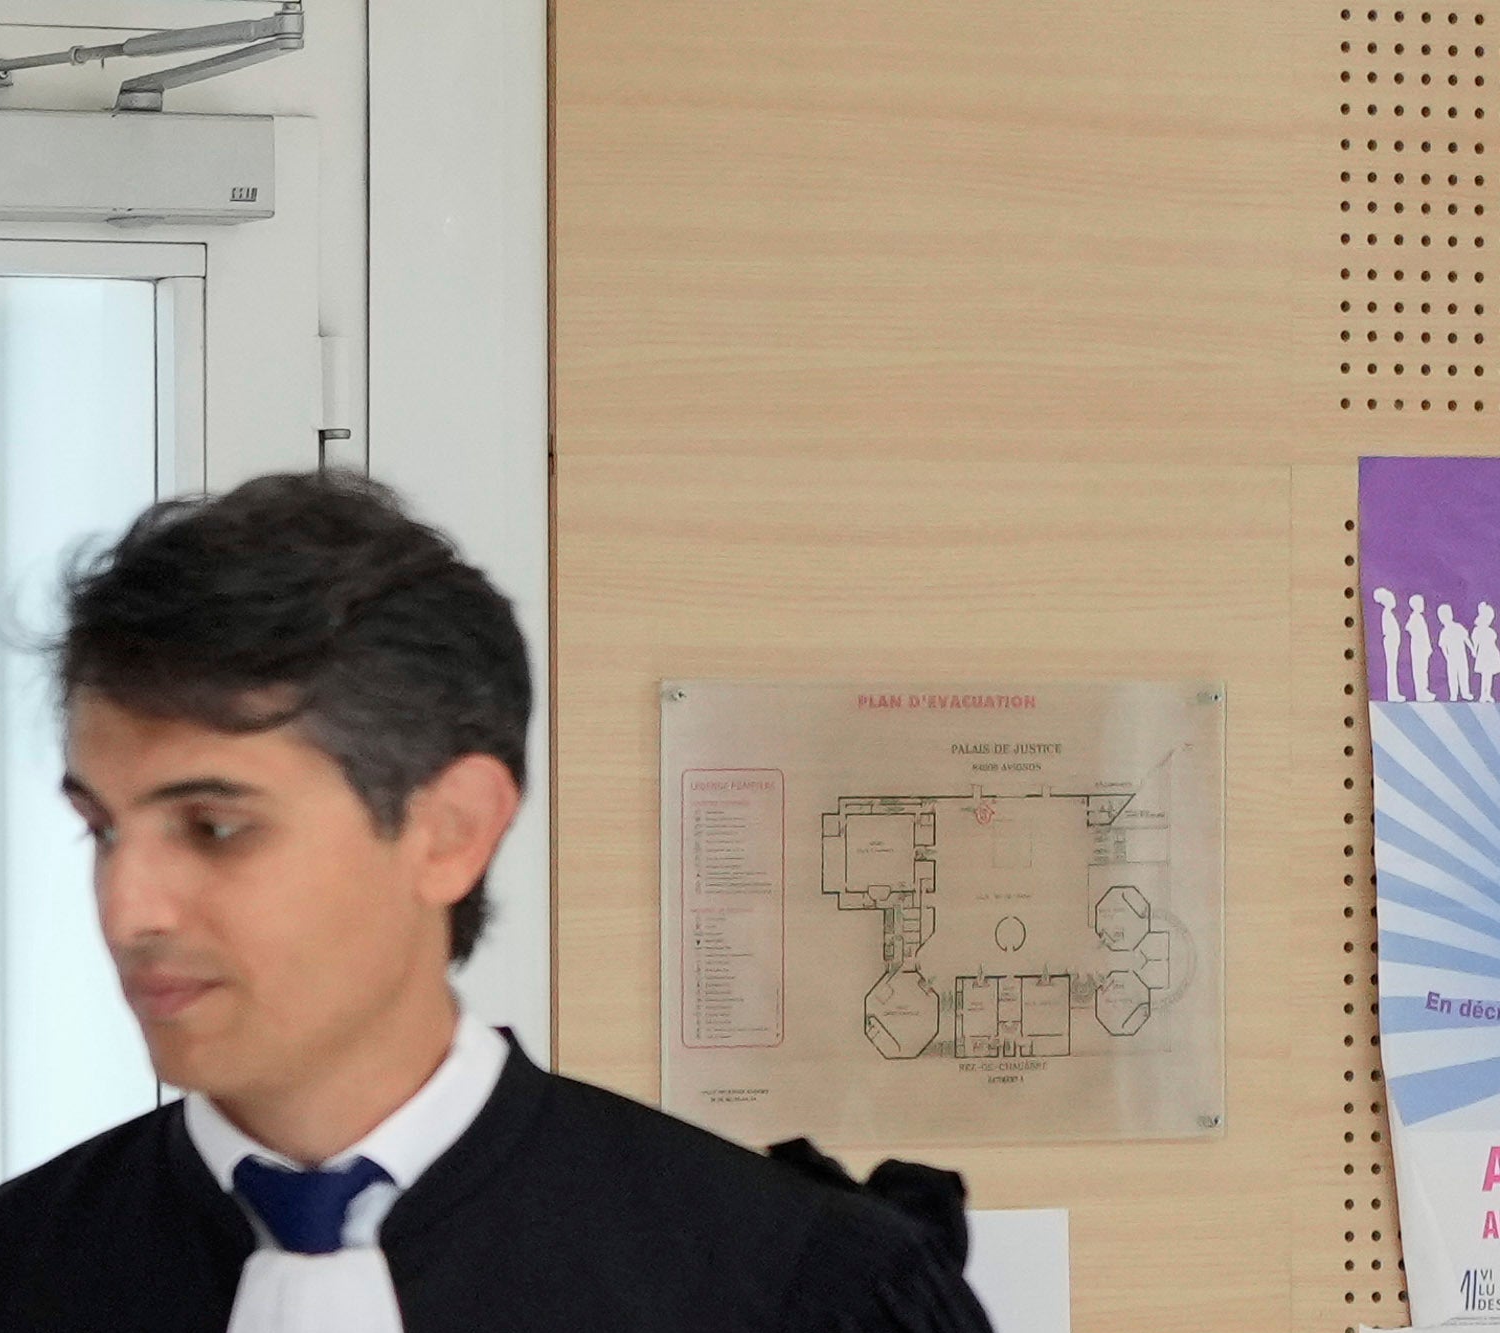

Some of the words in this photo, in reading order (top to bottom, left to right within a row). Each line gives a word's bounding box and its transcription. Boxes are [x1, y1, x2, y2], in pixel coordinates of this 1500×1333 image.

[951, 743, 990, 755] PALAIS
[994, 743, 1011, 755] DE
[1013, 743, 1062, 754] JUSTICE
[1425, 991, 1452, 1013] En
